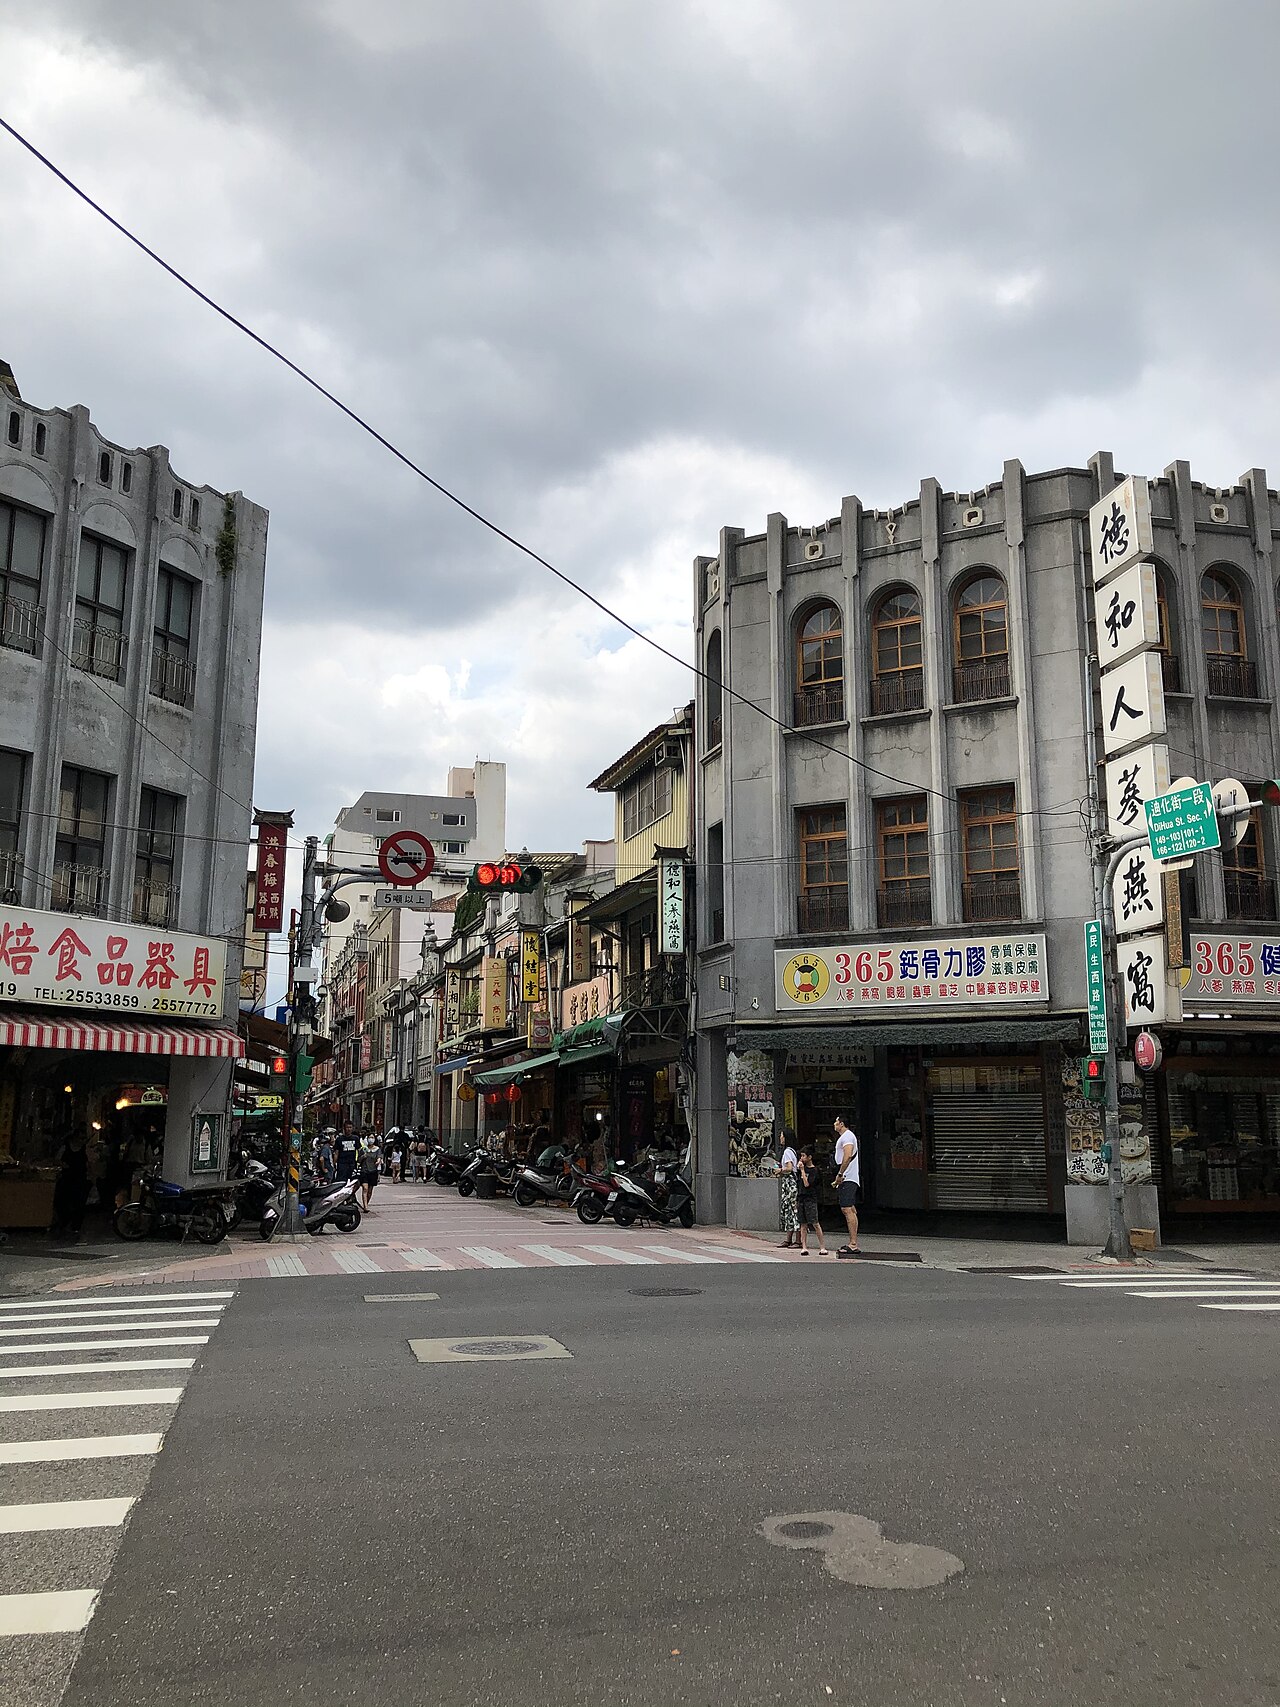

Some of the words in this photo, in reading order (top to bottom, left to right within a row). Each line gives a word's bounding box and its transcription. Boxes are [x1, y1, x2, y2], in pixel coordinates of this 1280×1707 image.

[1151, 788, 1204, 817] 迪化街一段
[1154, 820, 1174, 832] DiHua
[1175, 817, 1185, 827] St.
[1186, 813, 1202, 824] Sec.
[263, 836, 280, 887] 洪春梅
[384, 893, 425, 904] 5噸以上
[990, 942, 1038, 959] 骨質保健
[1196, 941, 1256, 977] 365
[0, 922, 217, 999] 焙食品器具
[792, 956, 821, 969] 365
[834, 950, 895, 984] 365
[899, 946, 987, 980] 鈣骨力膠
[991, 960, 1039, 976] 滋養皮膚
[1089, 934, 1101, 1002] 民生西路
[861, 987, 880, 1000] 燕窩
[912, 984, 932, 999] 蟲草
[939, 983, 959, 997] 靈芝
[1232, 979, 1256, 995] 燕窩
[1264, 980, 1280, 995] 冬
[151, 998, 217, 1015] 25577772
[1090, 1013, 1105, 1021] Sheng
[1070, 1157, 1106, 1176] 燕窩
